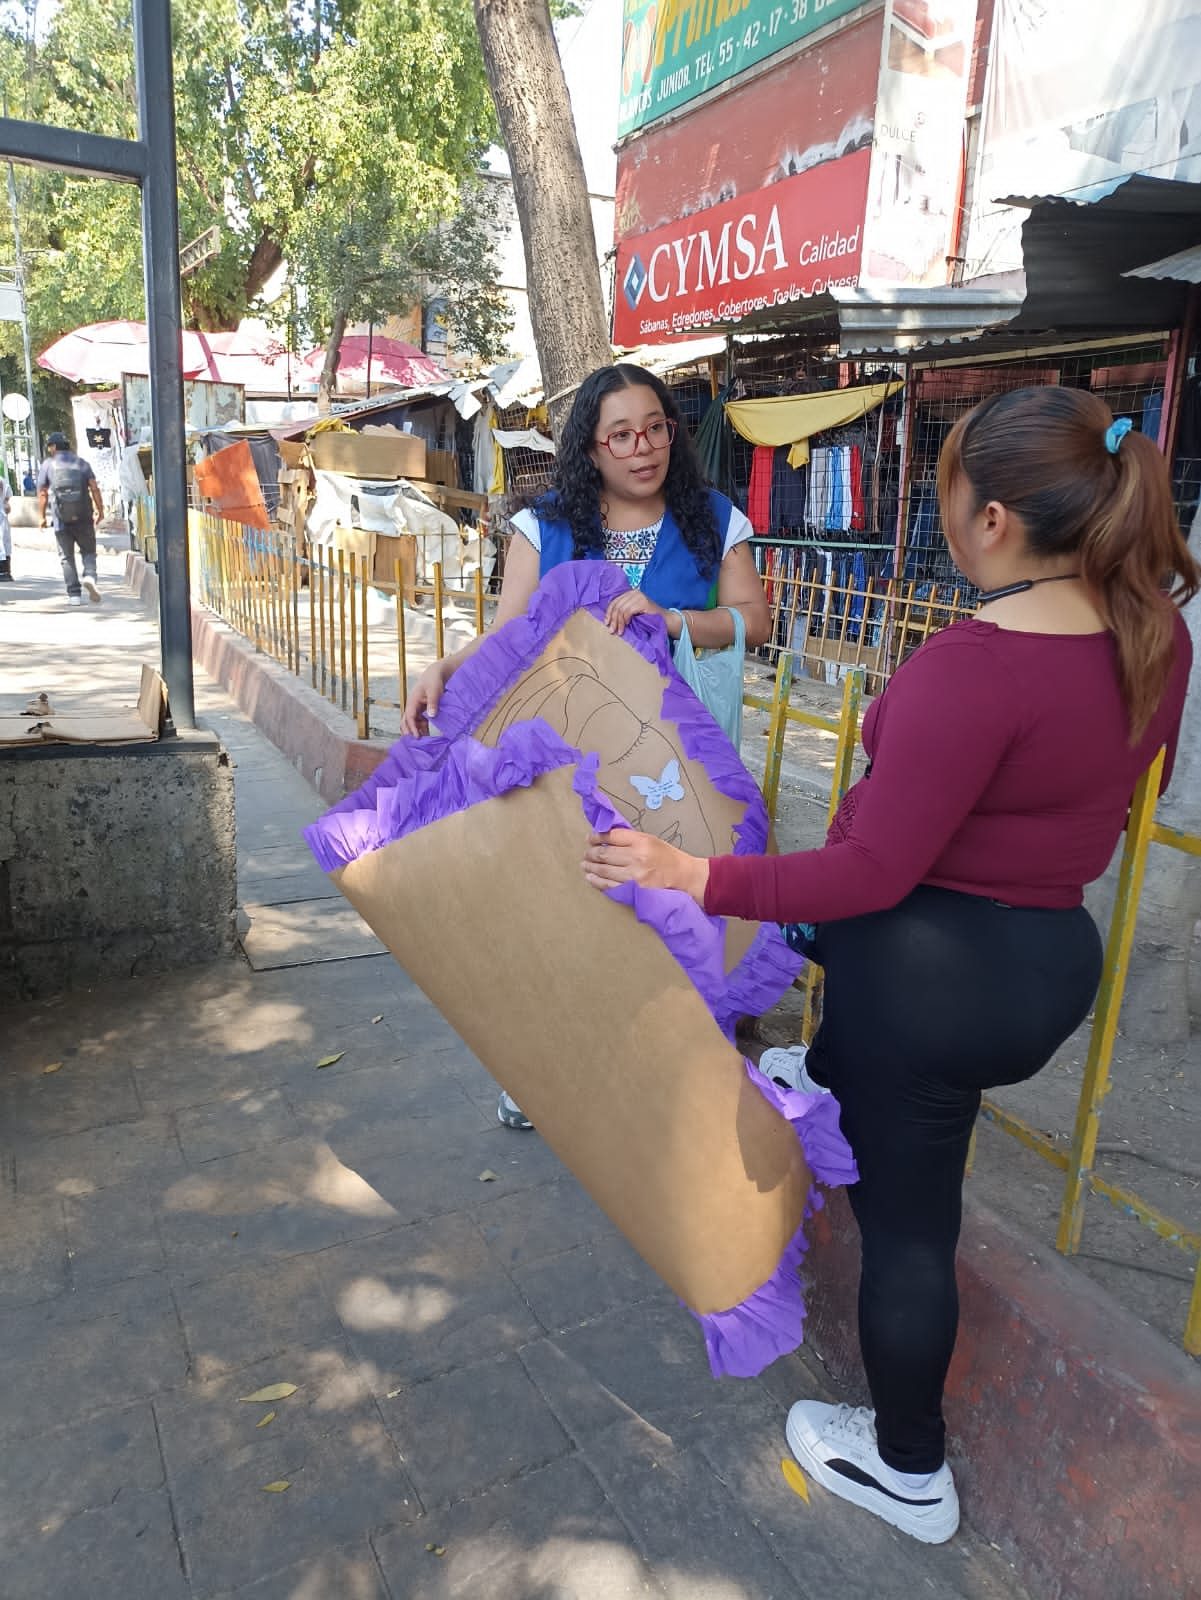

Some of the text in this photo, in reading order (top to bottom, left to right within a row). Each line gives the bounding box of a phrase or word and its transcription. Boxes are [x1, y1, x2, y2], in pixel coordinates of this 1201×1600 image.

[695, 50, 714, 80] TEL.
[648, 204, 860, 302] CYMSA Calidad
